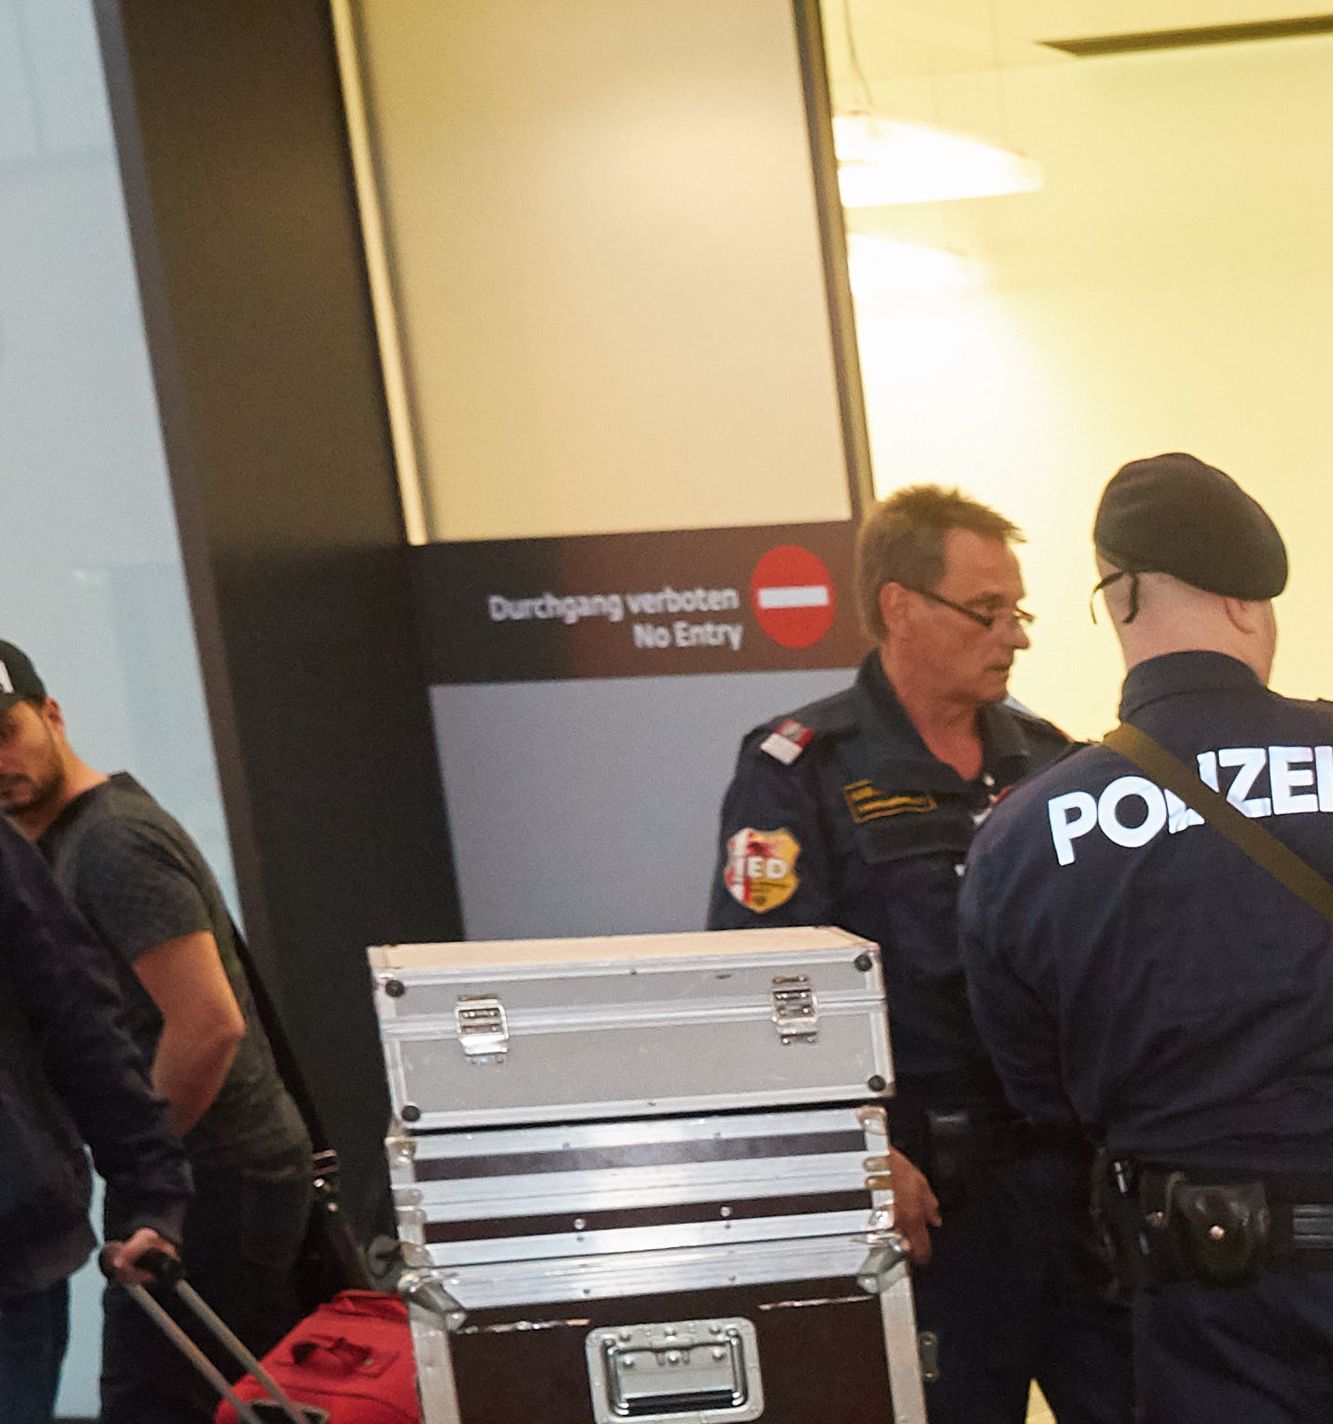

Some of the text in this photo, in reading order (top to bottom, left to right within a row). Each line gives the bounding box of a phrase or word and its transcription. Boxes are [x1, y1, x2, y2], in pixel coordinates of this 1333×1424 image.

[488, 586, 740, 625] Durchgang verboten
[632, 620, 743, 651] No Entry
